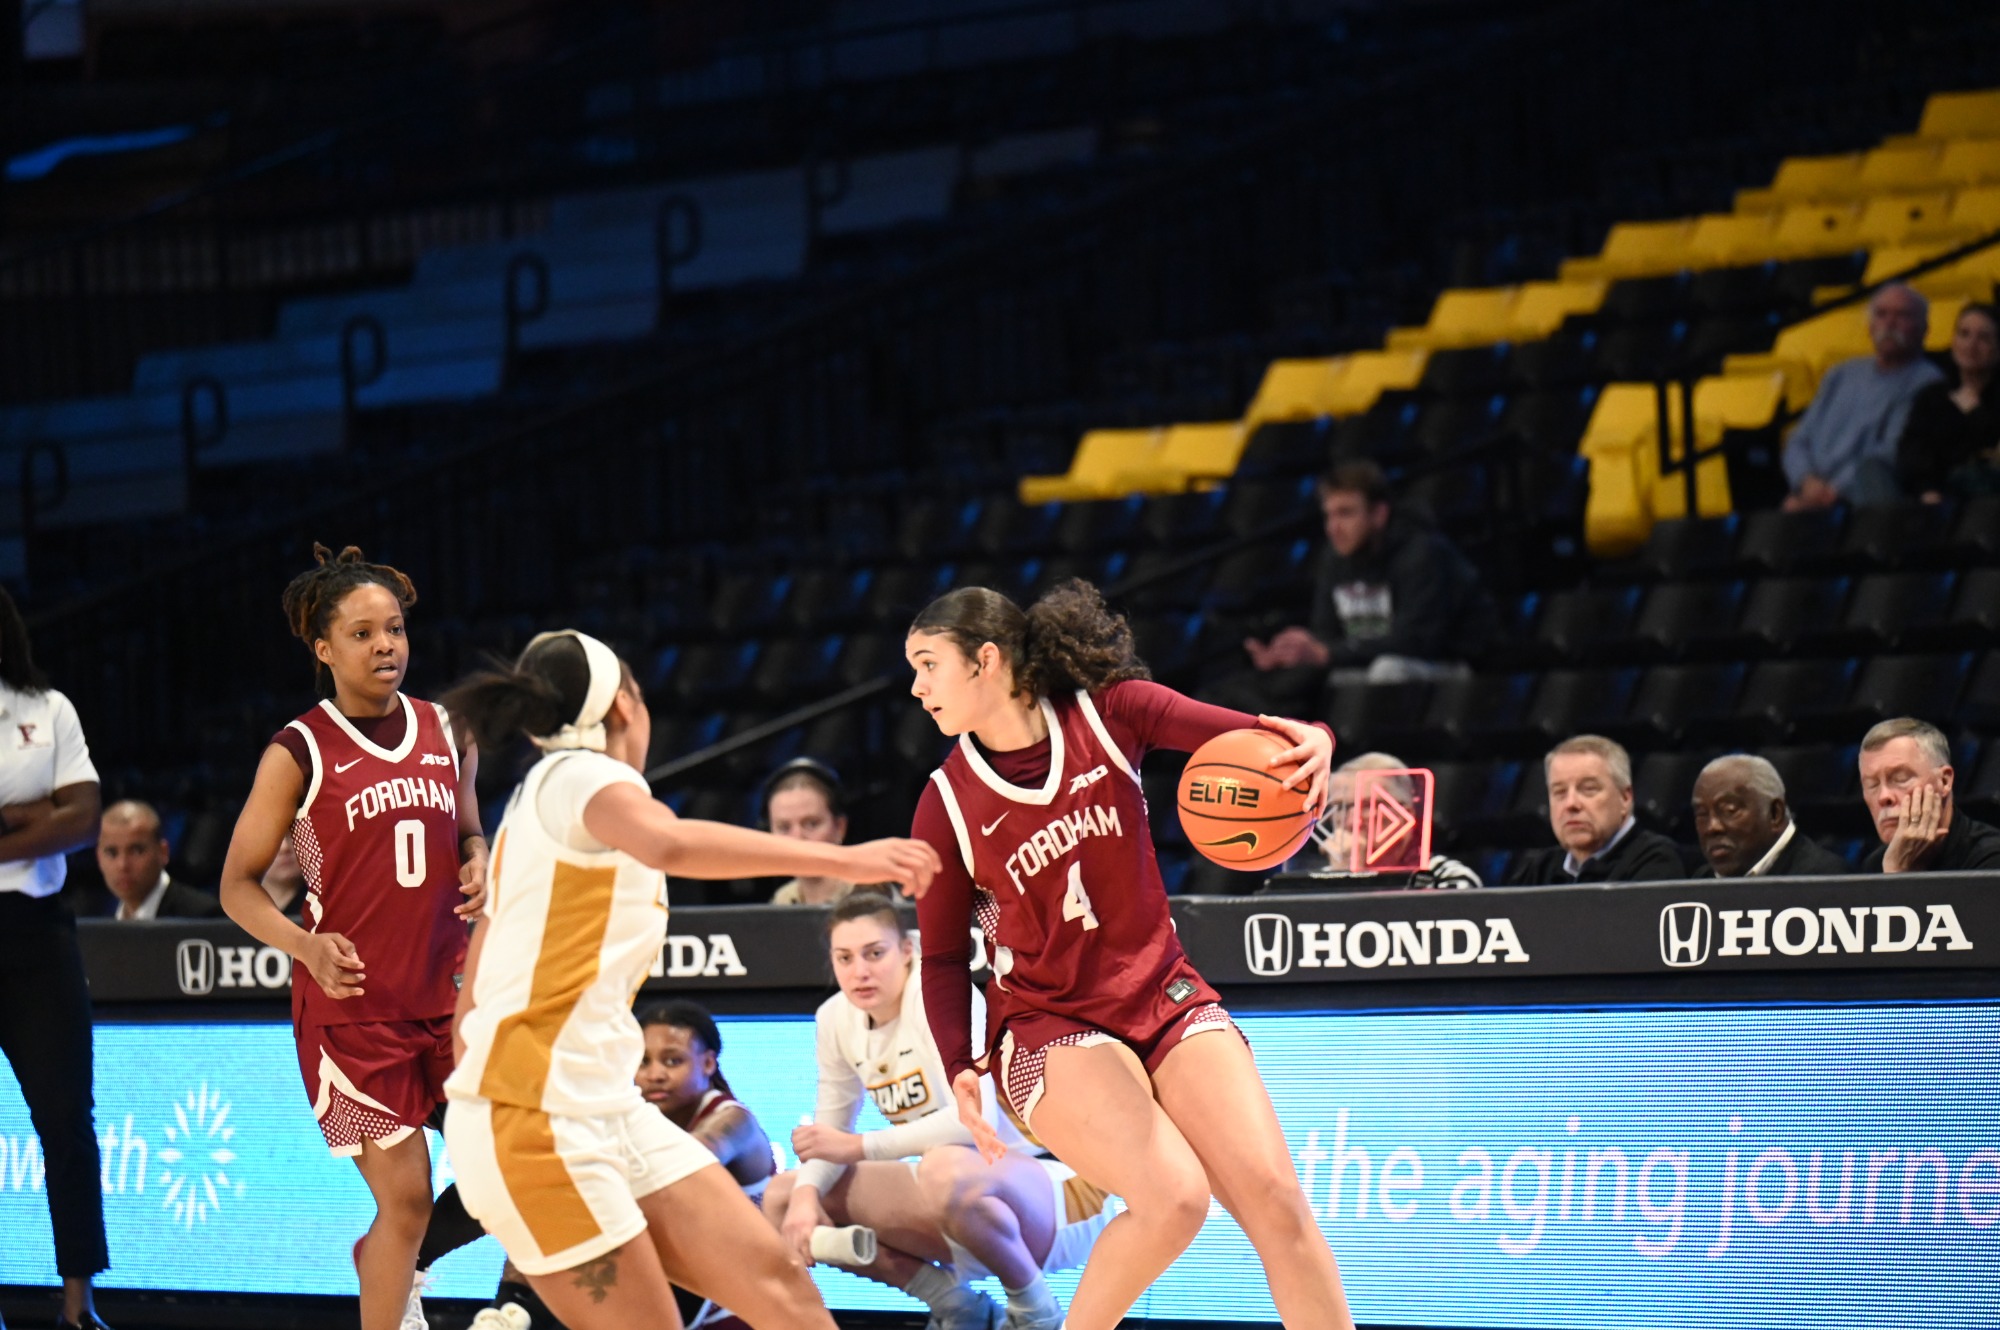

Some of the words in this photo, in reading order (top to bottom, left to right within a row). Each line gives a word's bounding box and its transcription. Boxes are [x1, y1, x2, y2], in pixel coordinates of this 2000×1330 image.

[345, 777, 456, 833] FORDHAM
[394, 819, 427, 888] 0
[1005, 804, 1123, 896] FORDHAM
[1062, 860, 1099, 932] 4
[1297, 918, 1530, 968] HONDA
[1717, 904, 1974, 957] HONDA
[217, 946, 292, 988] HO
[871, 1073, 928, 1114] AMS
[1299, 1106, 1425, 1220] the
[1449, 1114, 1690, 1259] aging
